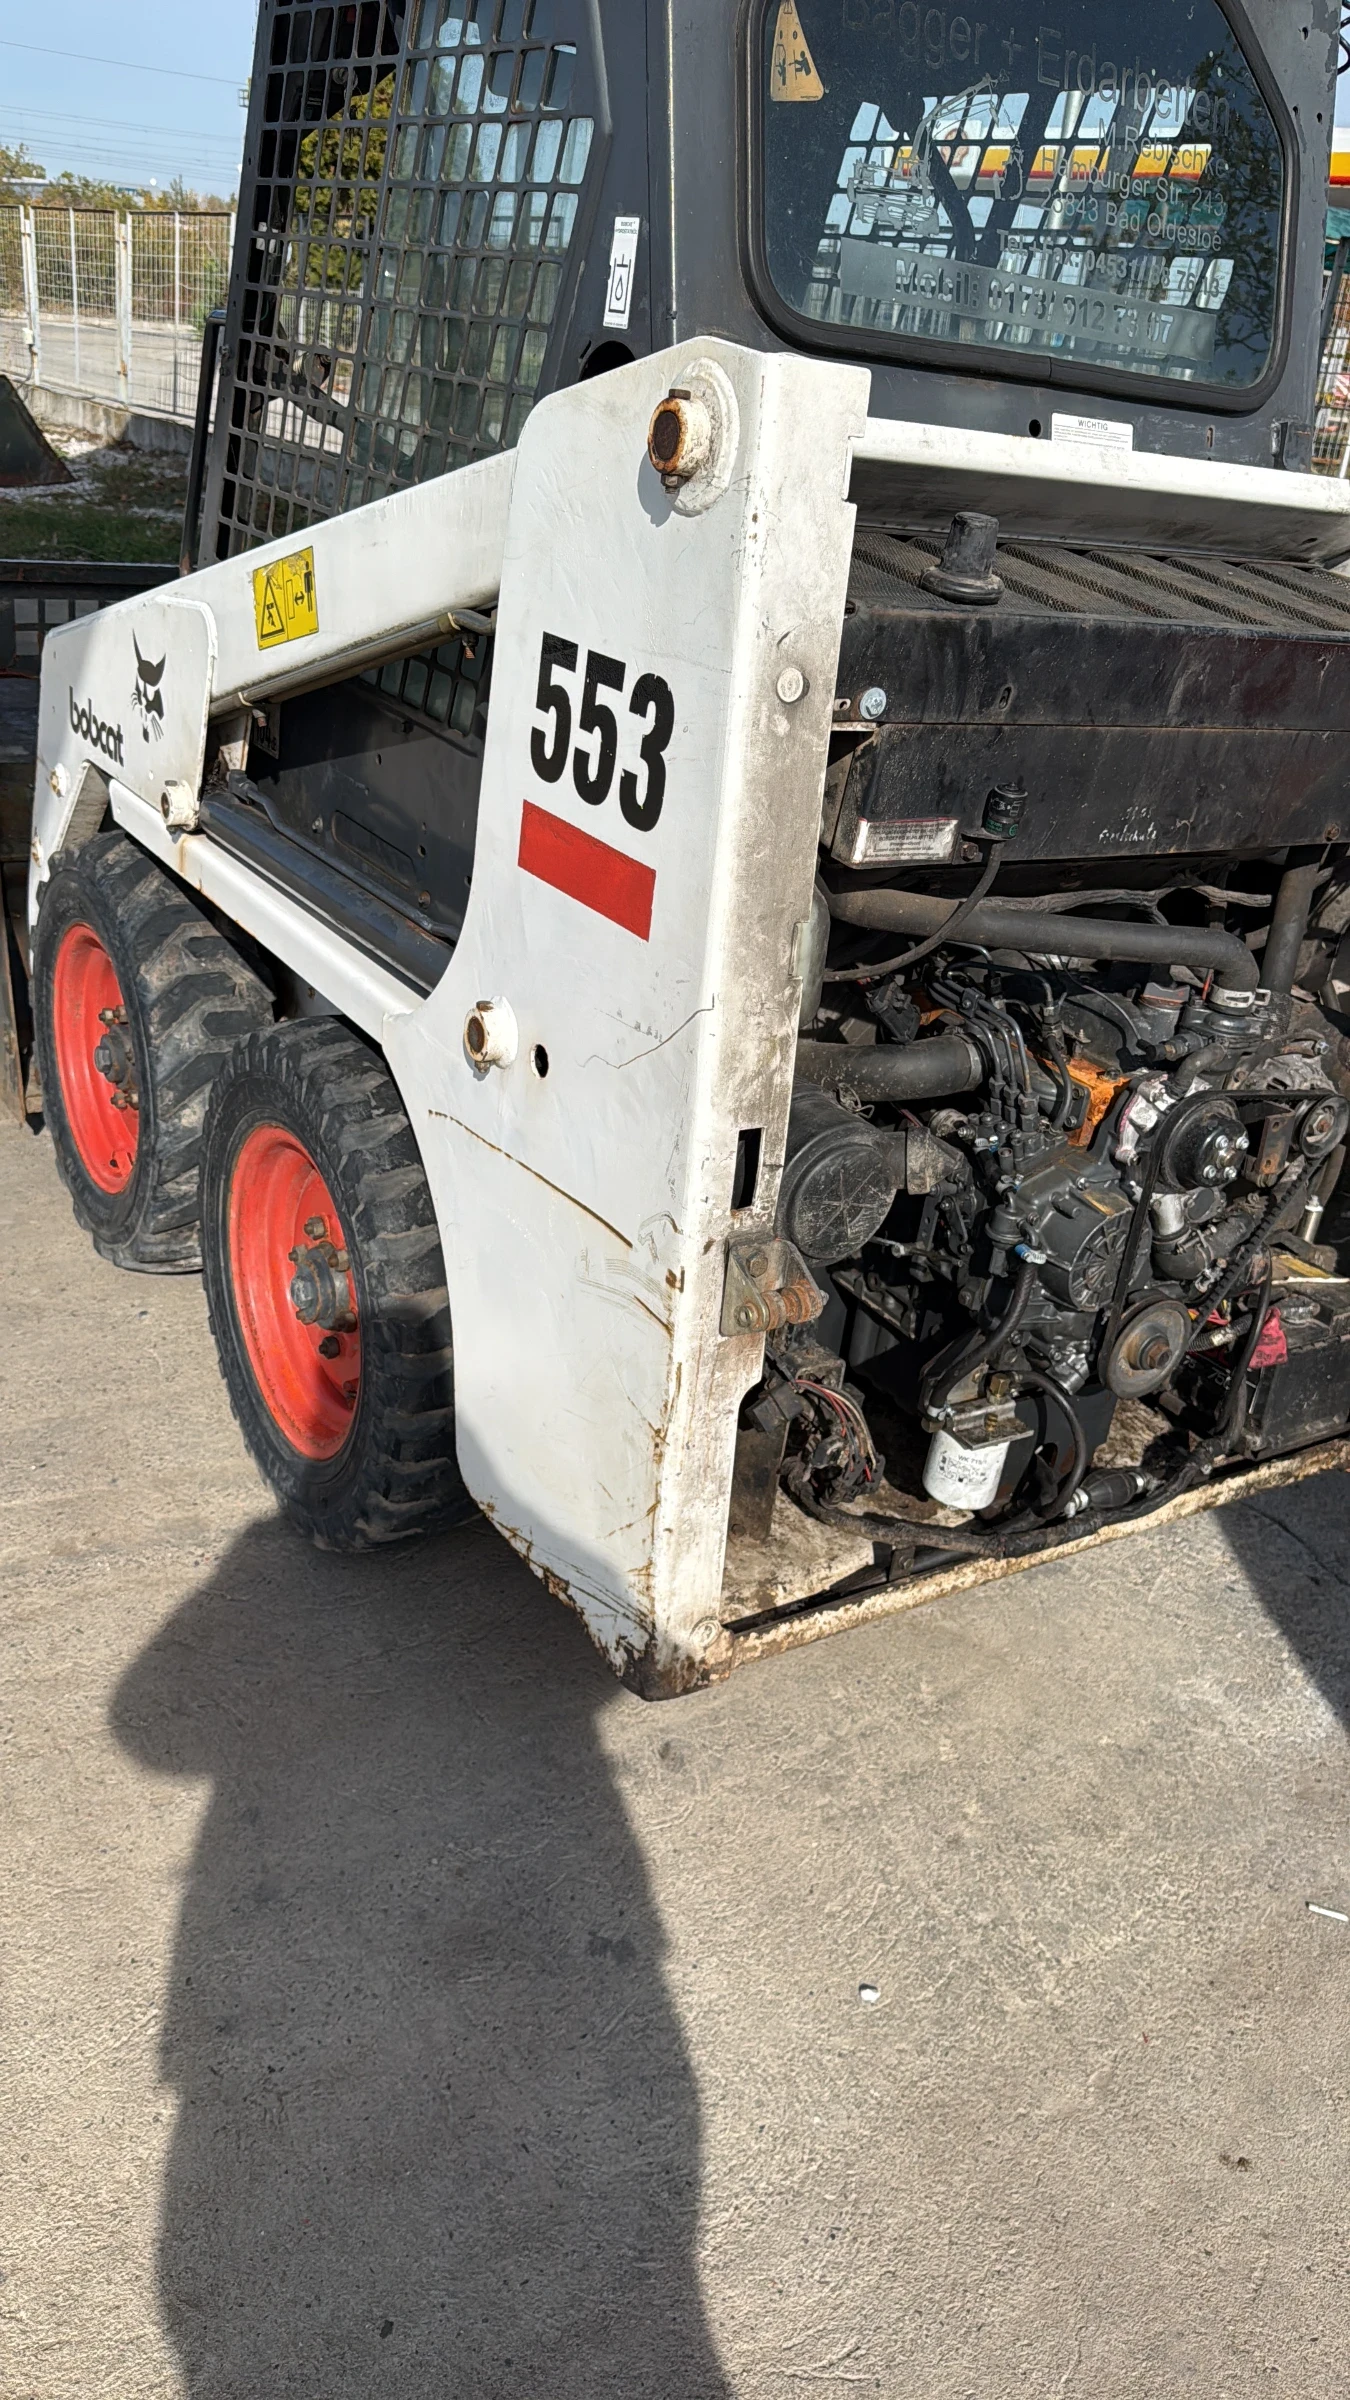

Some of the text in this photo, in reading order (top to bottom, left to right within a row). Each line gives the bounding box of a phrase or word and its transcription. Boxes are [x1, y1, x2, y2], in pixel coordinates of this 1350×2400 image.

[1037, 26, 1230, 137] Erdarbeiten
[1041, 146, 1151, 199] Hamburger
[1041, 188, 1223, 251] 23843 Bad Oldesloe
[894, 259, 978, 307] Mobil:
[1062, 294, 1105, 332] 912
[1077, 418, 1109, 431] WICHTIG
[69, 685, 124, 768] bobcat
[530, 630, 675, 833] 553
